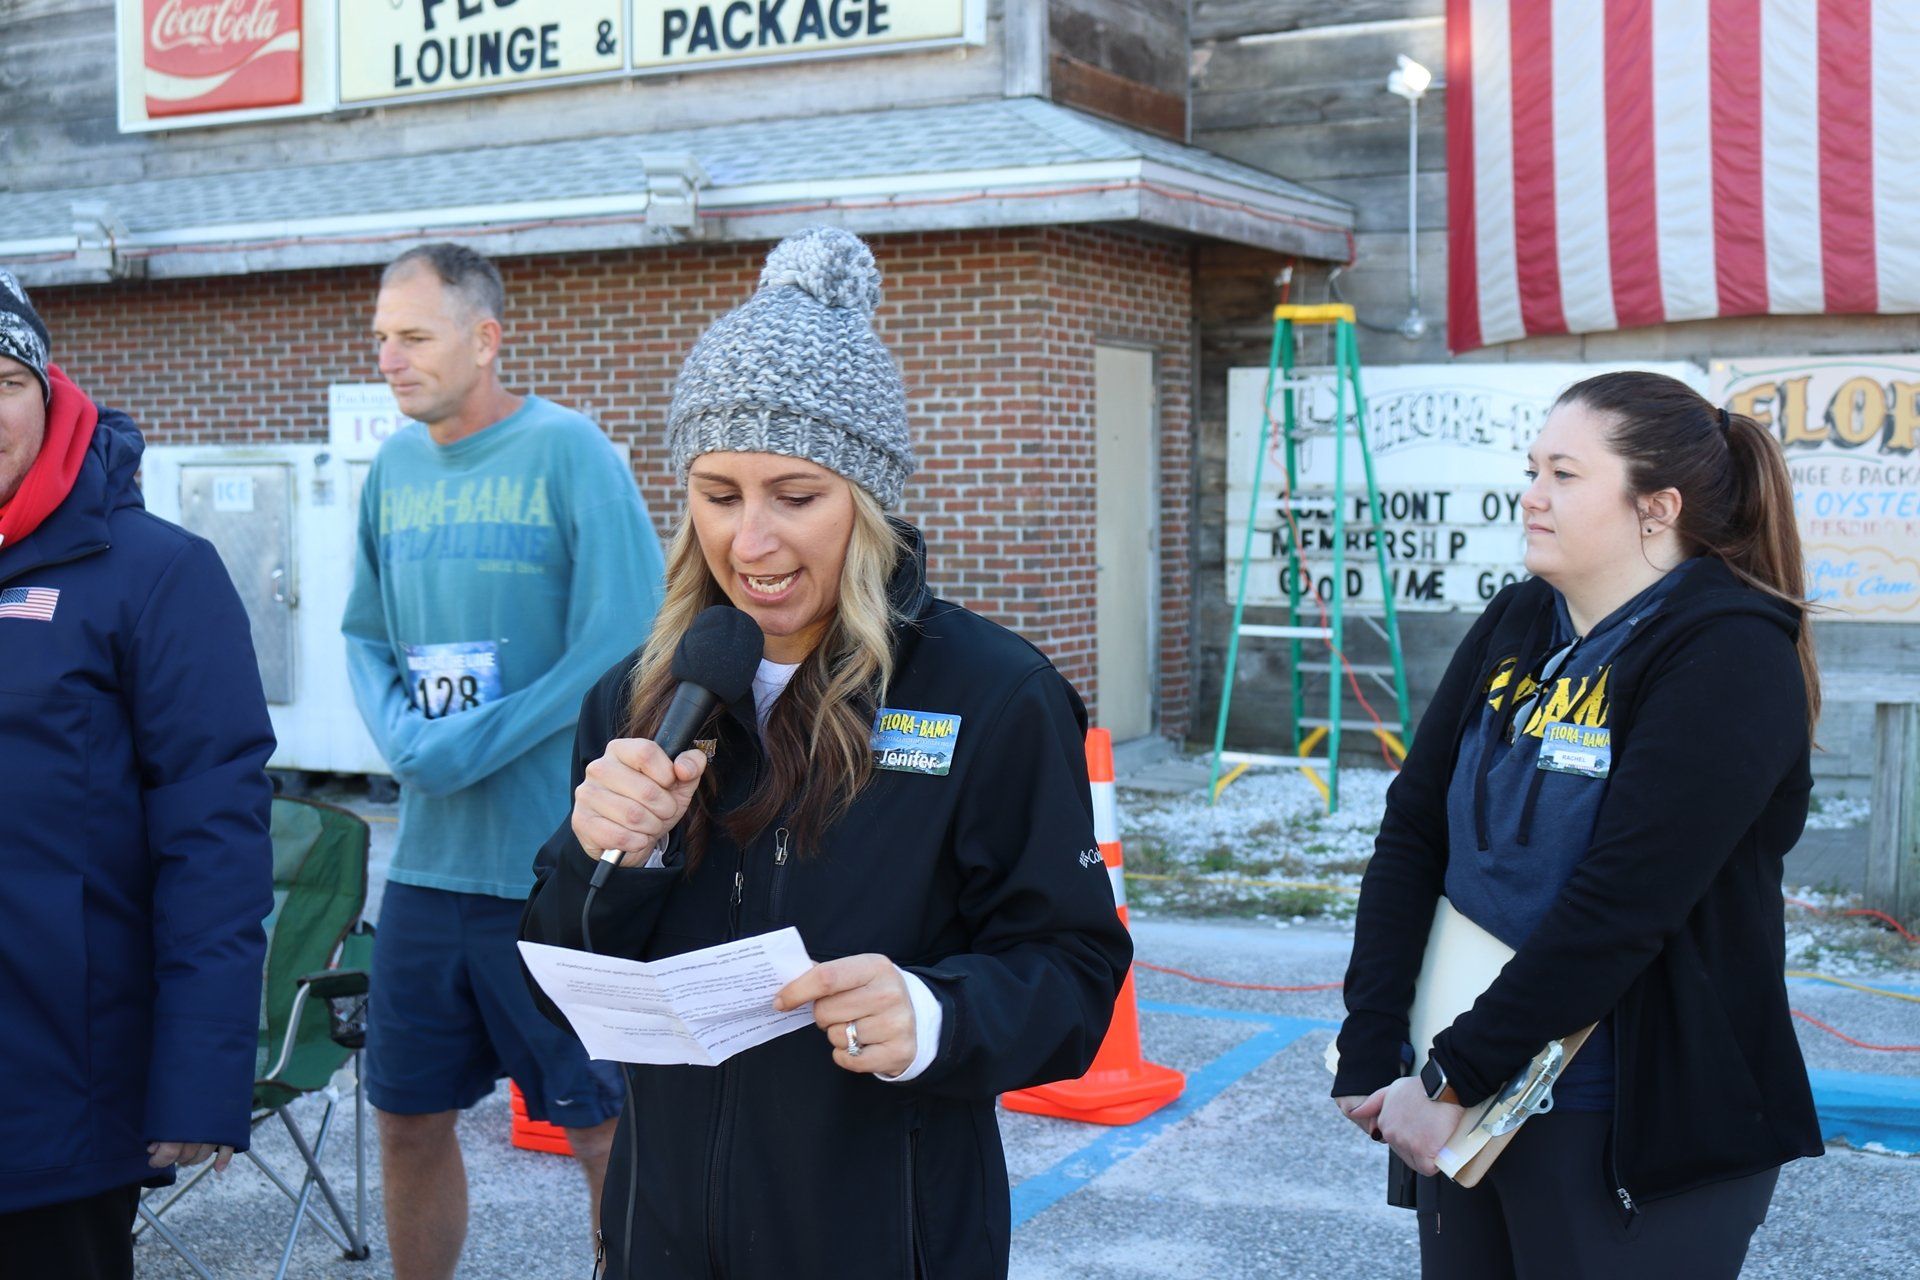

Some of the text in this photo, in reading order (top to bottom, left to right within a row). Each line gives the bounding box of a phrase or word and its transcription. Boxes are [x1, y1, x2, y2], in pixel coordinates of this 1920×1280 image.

[394, 0, 890, 88] LOUNGE & PACKAGE
[1791, 466, 1830, 486] NGE
[1482, 492, 1521, 521] OY
[1815, 491, 1920, 518] OYSTE
[418, 675, 481, 720] 128
[879, 713, 954, 739] FLORA-BAMA
[1549, 725, 1610, 749] FLORA-BAMA
[880, 748, 938, 770] Jenifer
